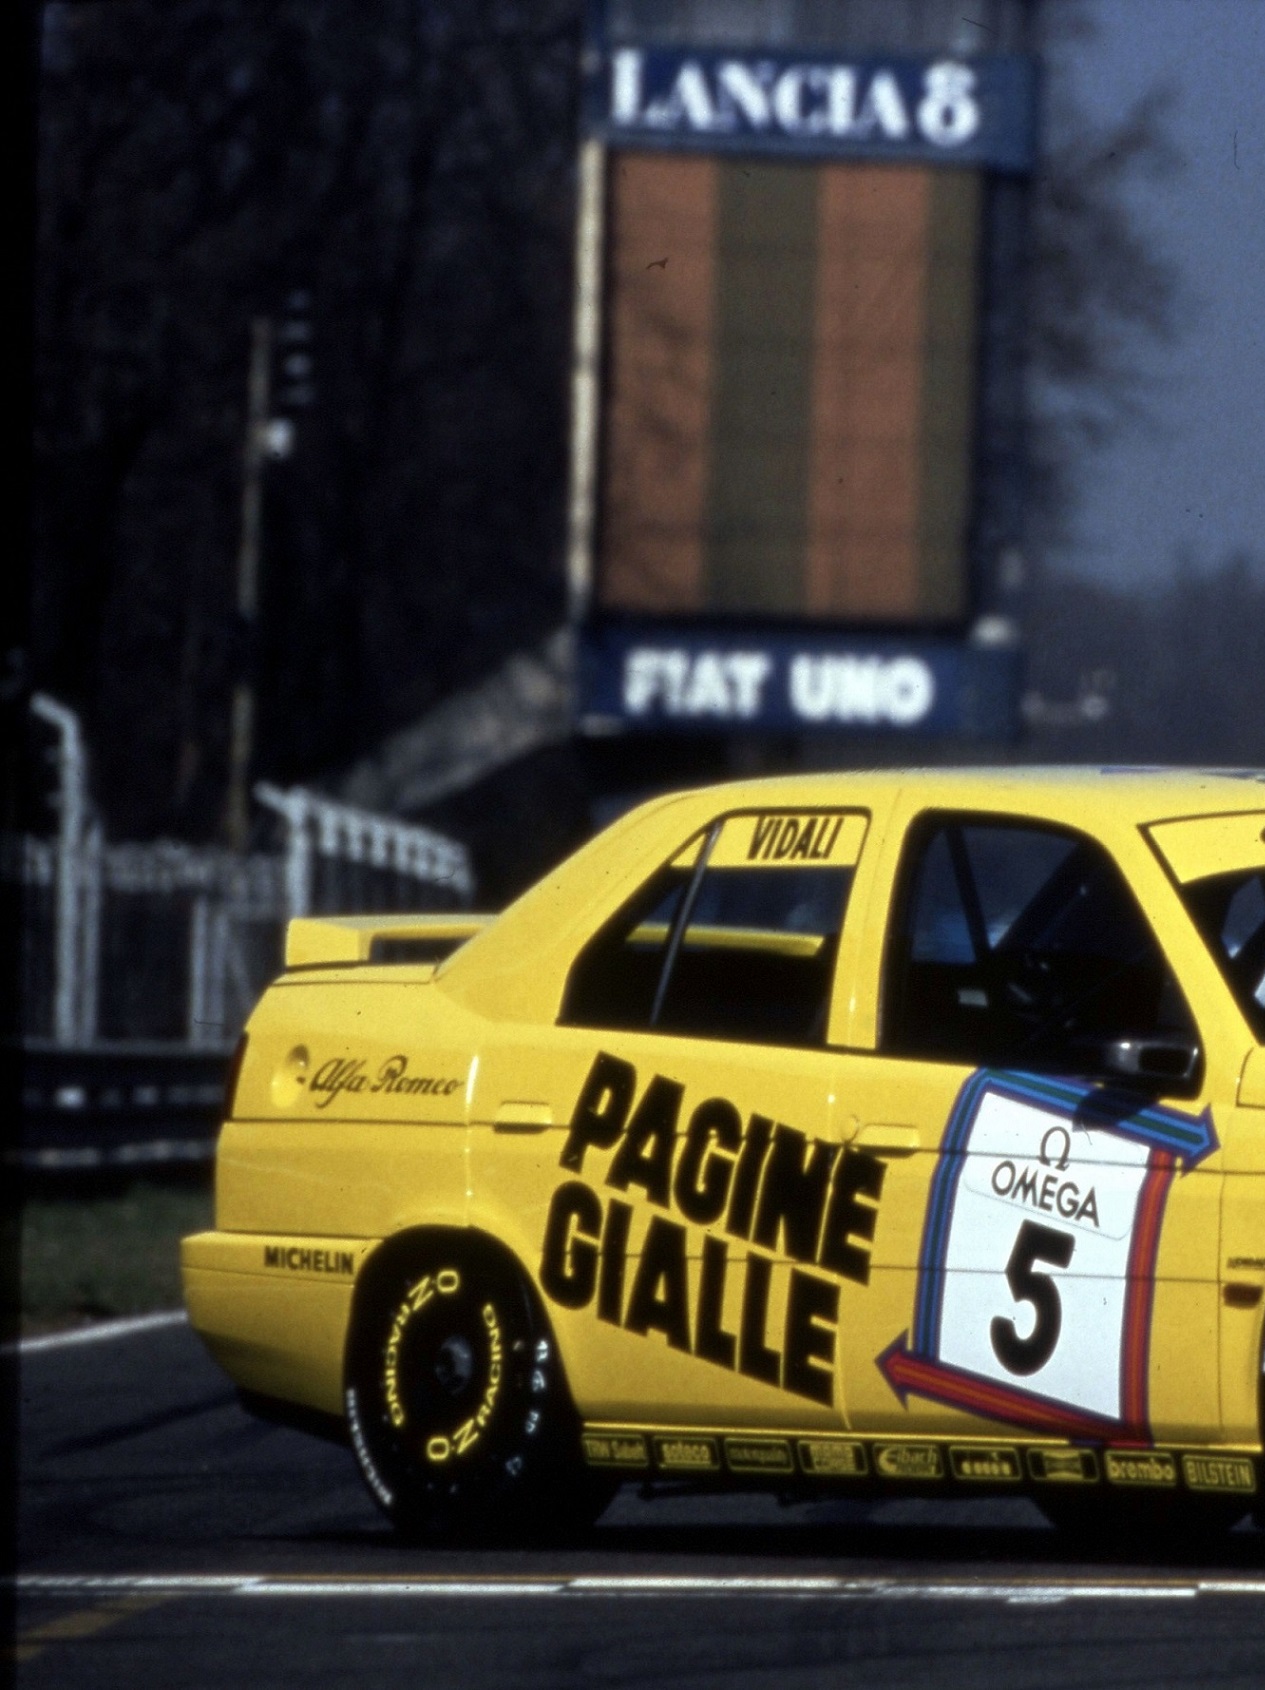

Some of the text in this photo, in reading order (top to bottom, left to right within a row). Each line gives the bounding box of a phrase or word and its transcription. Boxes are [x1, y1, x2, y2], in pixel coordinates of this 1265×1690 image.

[623, 647, 935, 726] FIAT UNO
[747, 815, 844, 861] VIDALI
[309, 1054, 465, 1109] Alfa Romeo
[558, 1050, 888, 1287] PAGINE
[991, 1160, 1100, 1228] OMEGA
[264, 1247, 354, 1275] MICHELIN
[539, 1180, 842, 1408] GIALLE
[990, 1219, 1076, 1377] 5
[385, 1303, 411, 1427] RACING
[476, 1303, 502, 1428] RACING
[1106, 1452, 1175, 1482] brembo
[1186, 1459, 1250, 1488] BILSTEIN
